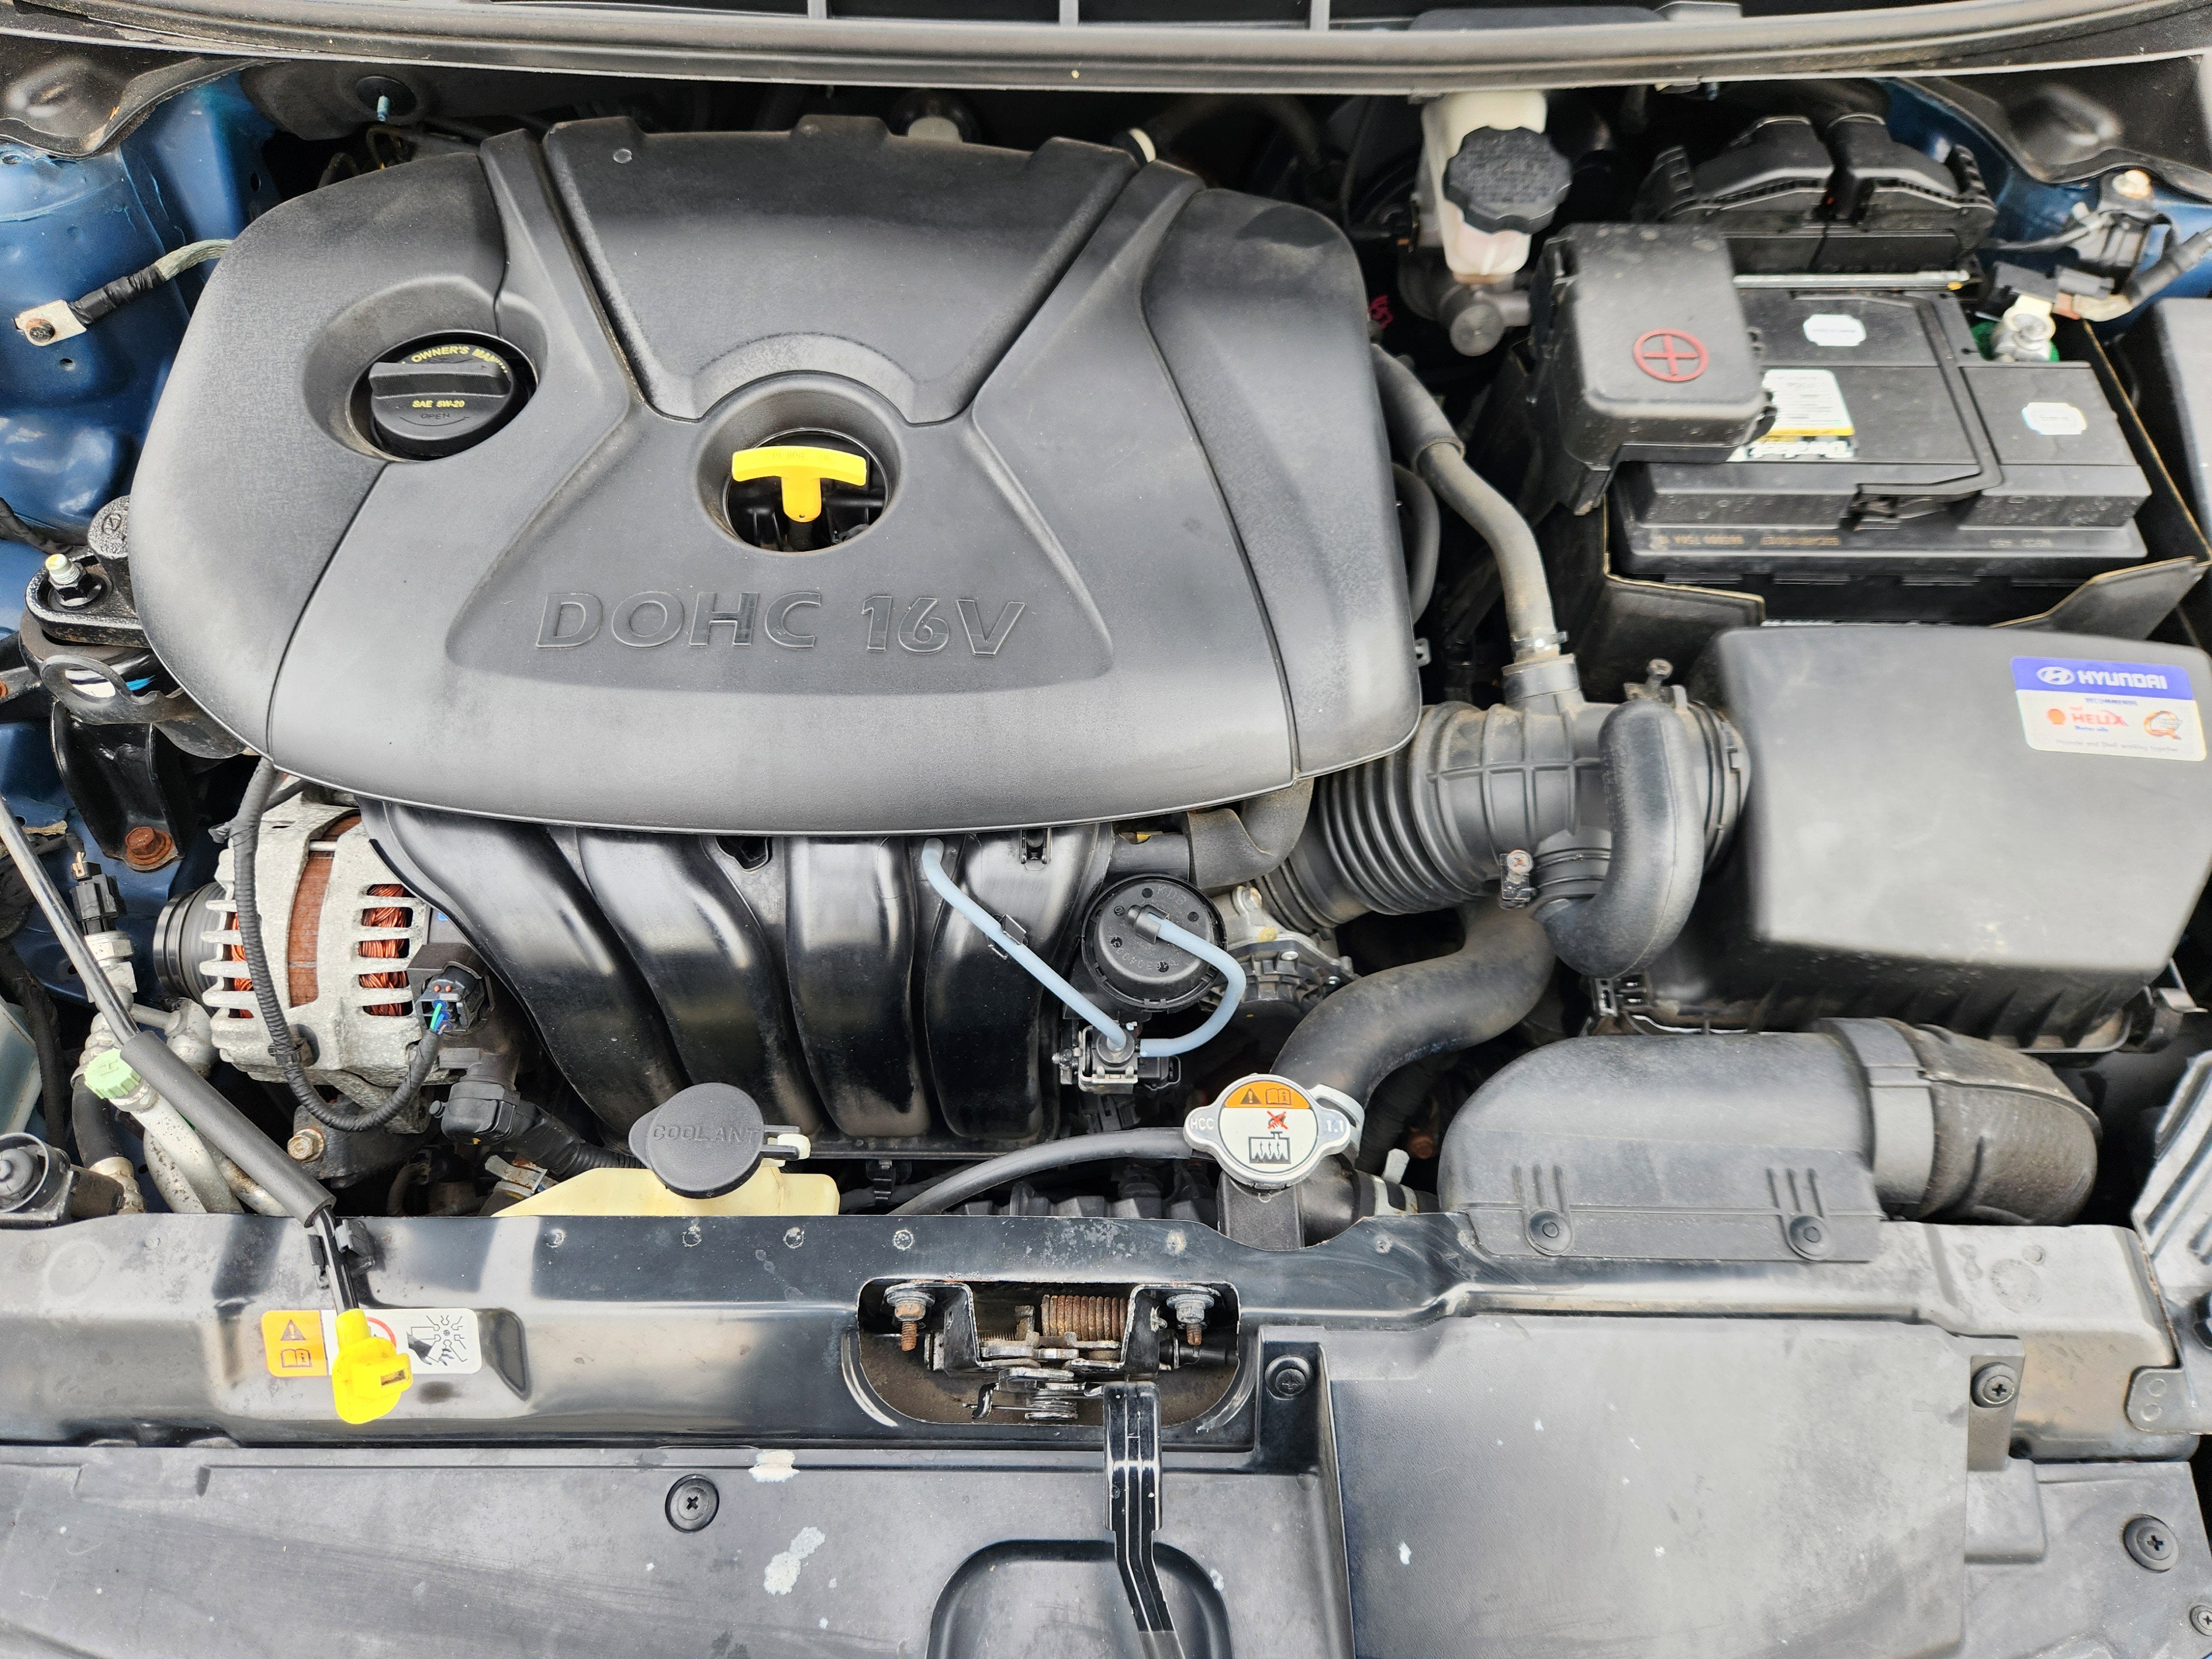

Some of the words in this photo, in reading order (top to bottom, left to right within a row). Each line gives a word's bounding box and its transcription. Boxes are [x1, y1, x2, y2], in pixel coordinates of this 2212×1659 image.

[411, 346, 470, 363] OWNER'S
[536, 592, 822, 649] DOHC
[862, 595, 1027, 656] 16V
[2077, 670, 2168, 690] HYUNDAI
[2071, 711, 2129, 727] HELIX
[1190, 1117, 1215, 1130] HCC
[1327, 1119, 1345, 1133] 1.1
[653, 1124, 759, 1144] COOLANT
